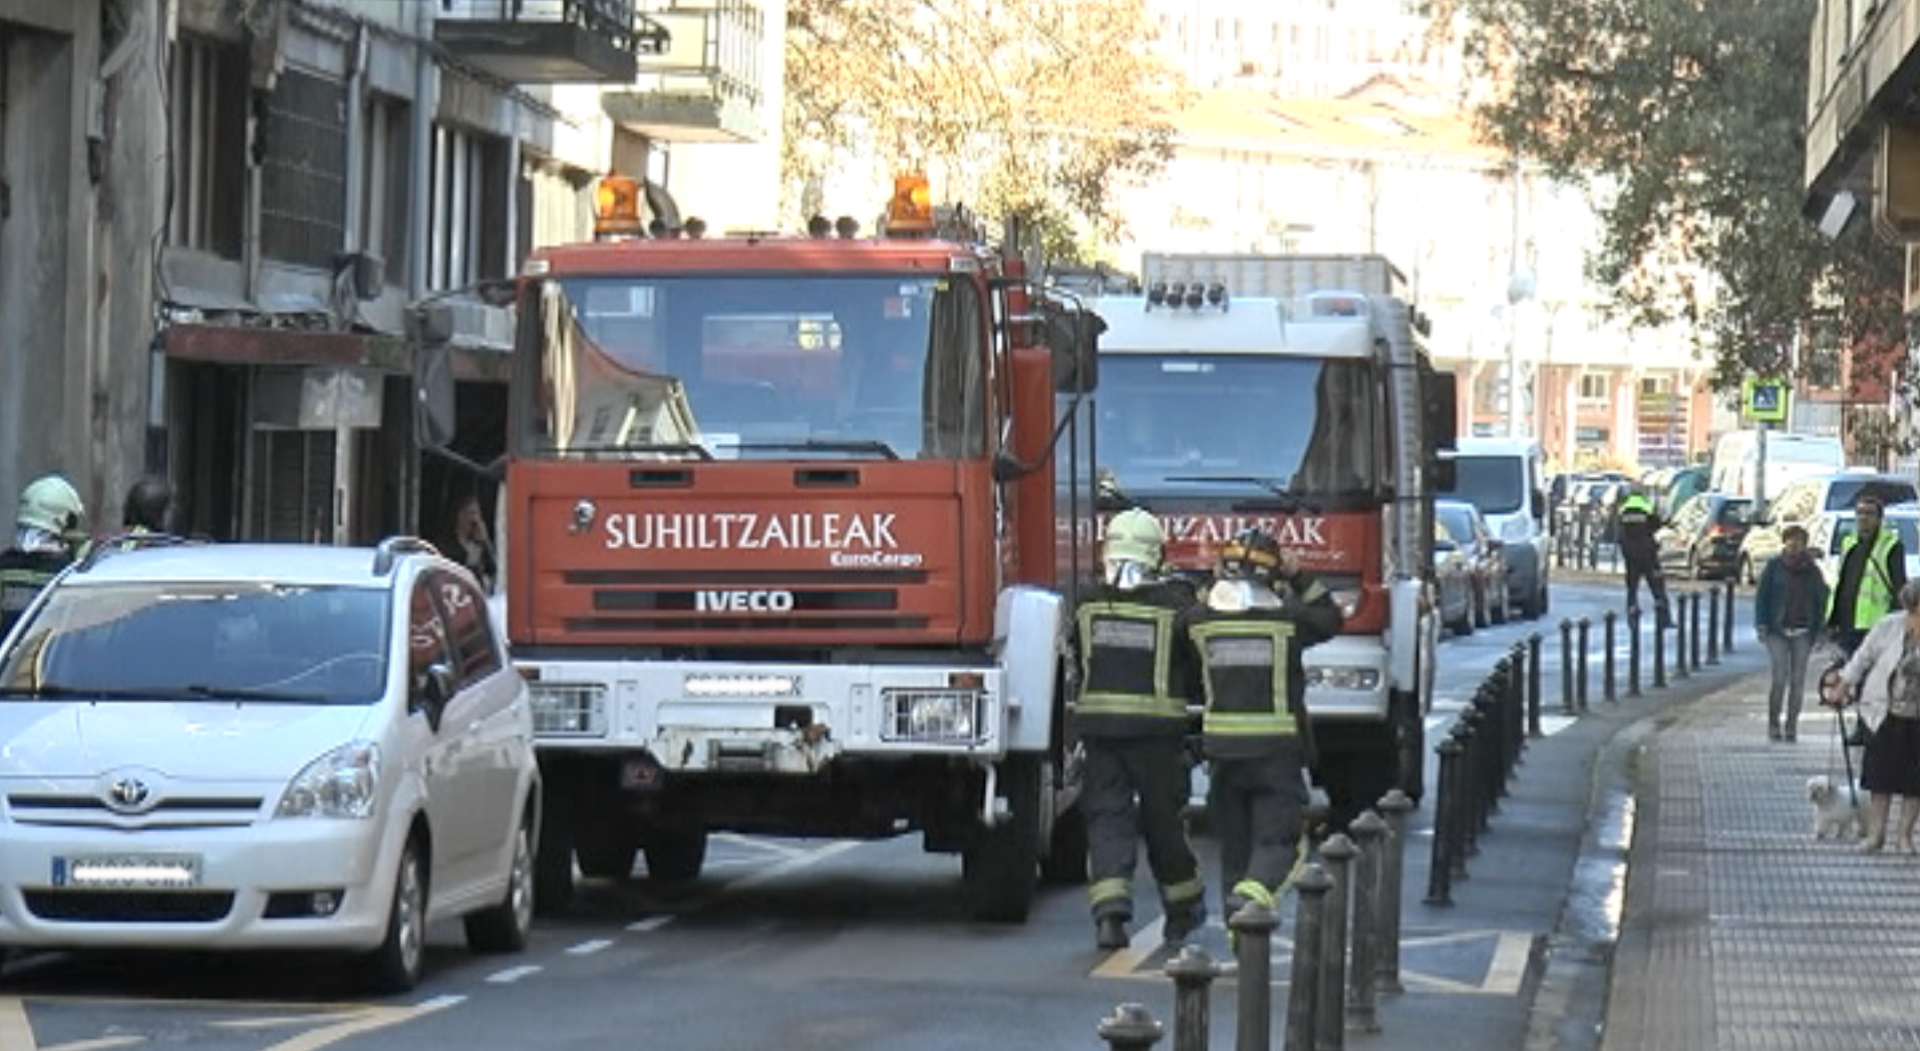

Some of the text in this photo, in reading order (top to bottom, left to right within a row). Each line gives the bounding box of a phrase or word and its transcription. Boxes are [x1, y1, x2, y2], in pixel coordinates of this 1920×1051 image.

[605, 513, 898, 549] SUHILTZAILEAK
[829, 551, 922, 567] EuroCargo
[695, 590, 795, 612] IVECO
